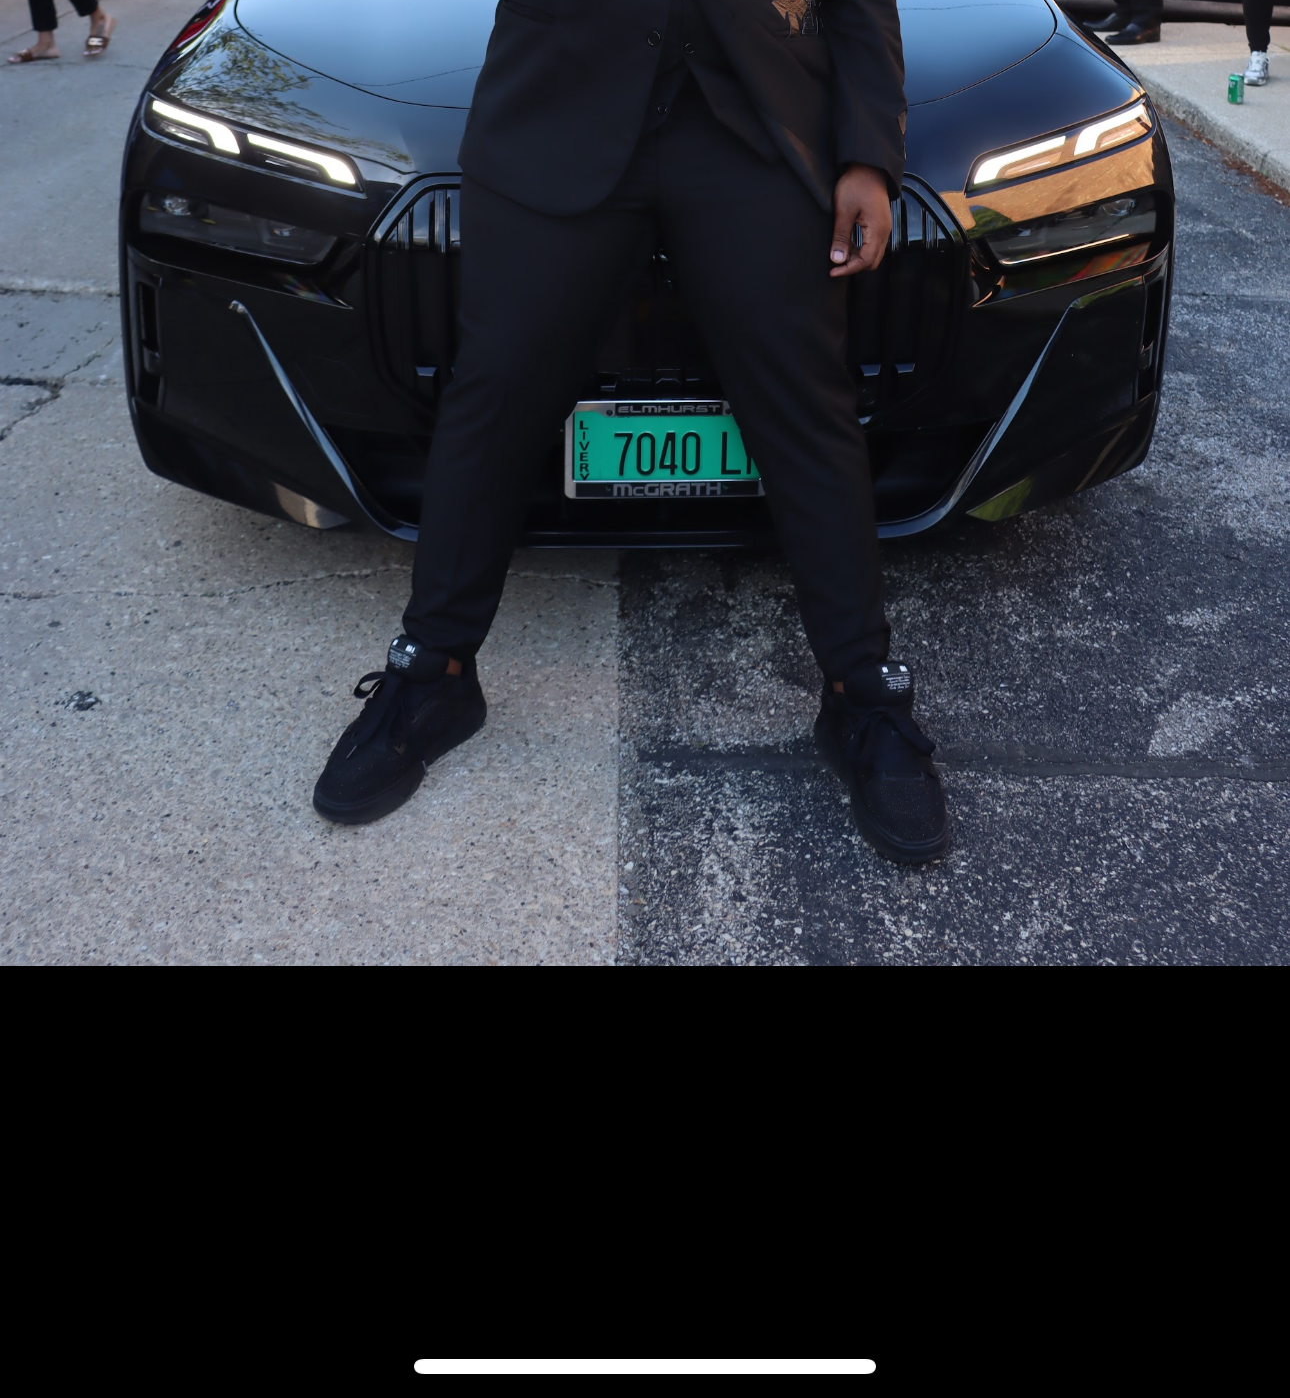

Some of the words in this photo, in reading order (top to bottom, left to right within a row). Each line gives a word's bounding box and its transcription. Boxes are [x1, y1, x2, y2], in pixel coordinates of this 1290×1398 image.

[617, 405, 720, 414] ELMHURST
[579, 420, 590, 481] LIVERY
[614, 431, 701, 476] 7040
[613, 483, 721, 497] McGRATH
